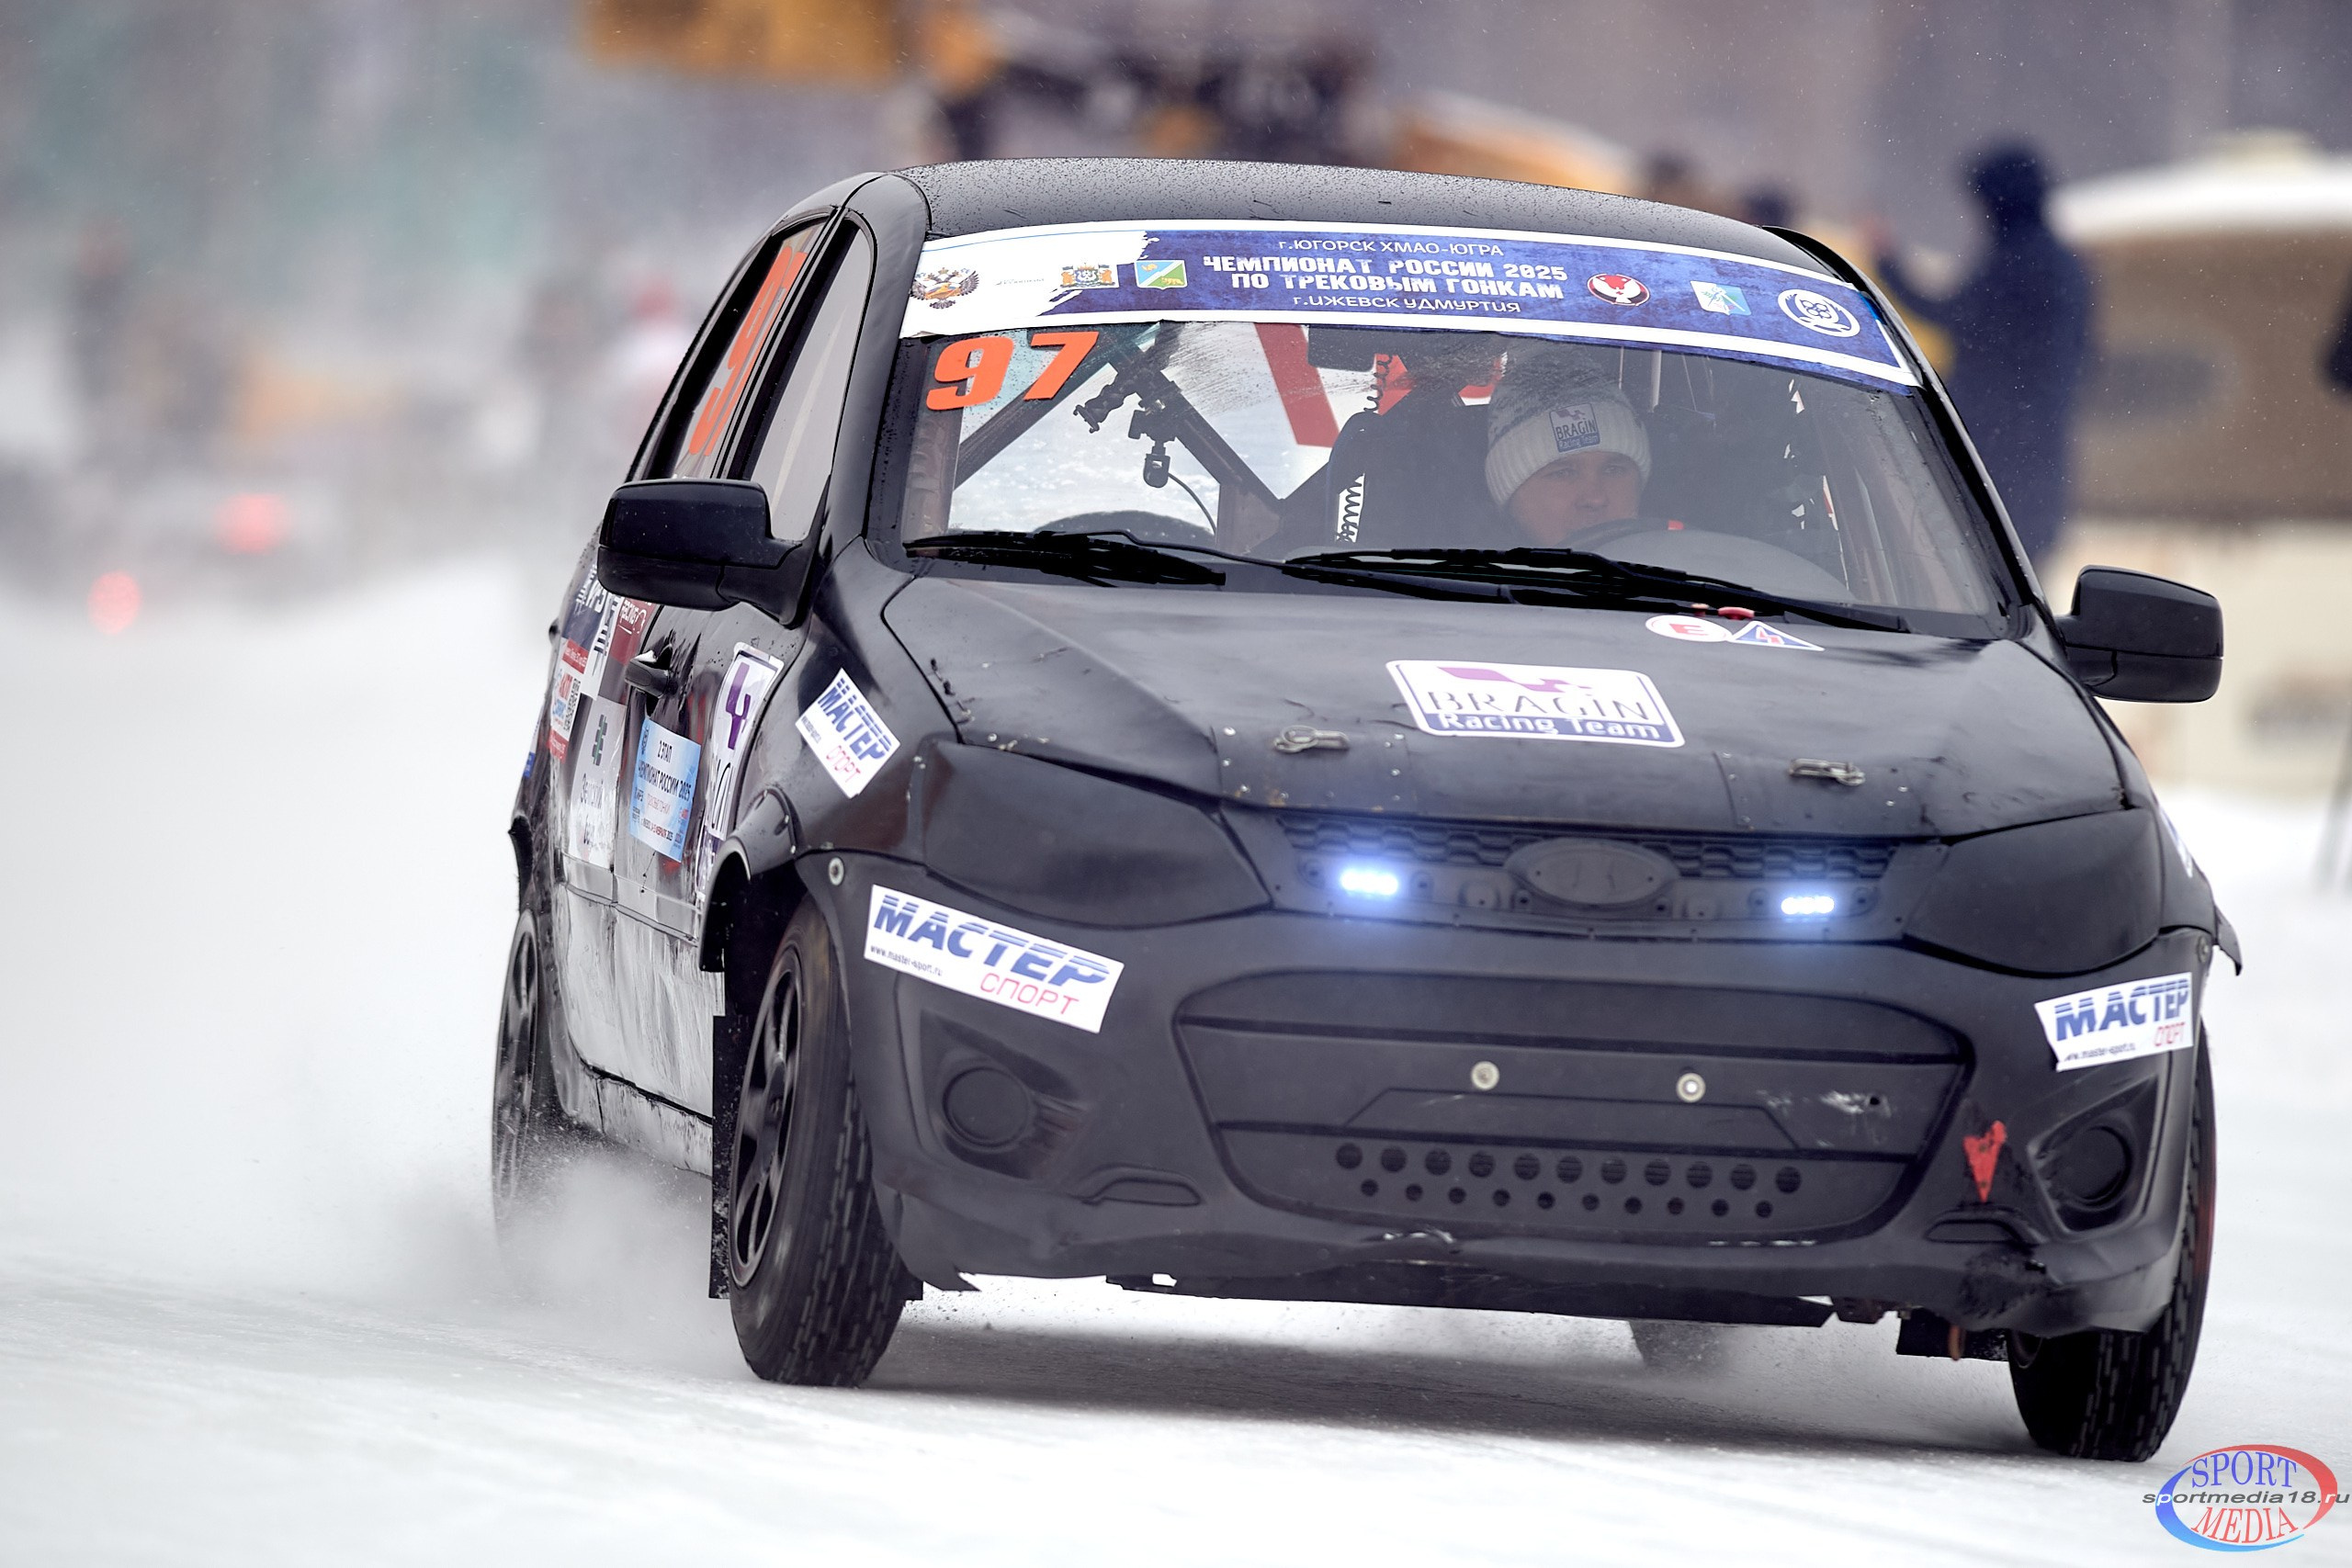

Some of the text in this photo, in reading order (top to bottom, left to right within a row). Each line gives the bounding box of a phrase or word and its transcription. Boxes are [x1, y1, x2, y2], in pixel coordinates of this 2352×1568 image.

[1380, 242, 1503, 256] ХМАО-ЮГРА
[1204, 255, 1568, 280] ЧЕМПИОНАТ РОССИИ 2025
[1231, 273, 1564, 299] ПО ТРЕКОВЫМ ГОНКАМ
[1402, 299, 1521, 312] УДМУРТИЯ
[926, 331, 1100, 411] 97
[818, 678, 891, 761] МАСТЕР
[1428, 690, 1650, 720] BRAGIN
[1438, 712, 1661, 739] Racing Team
[874, 894, 1110, 987] МАСТЕР
[978, 972, 1080, 1015] СПОРТ
[2054, 978, 2188, 1042] МАСТЕР
